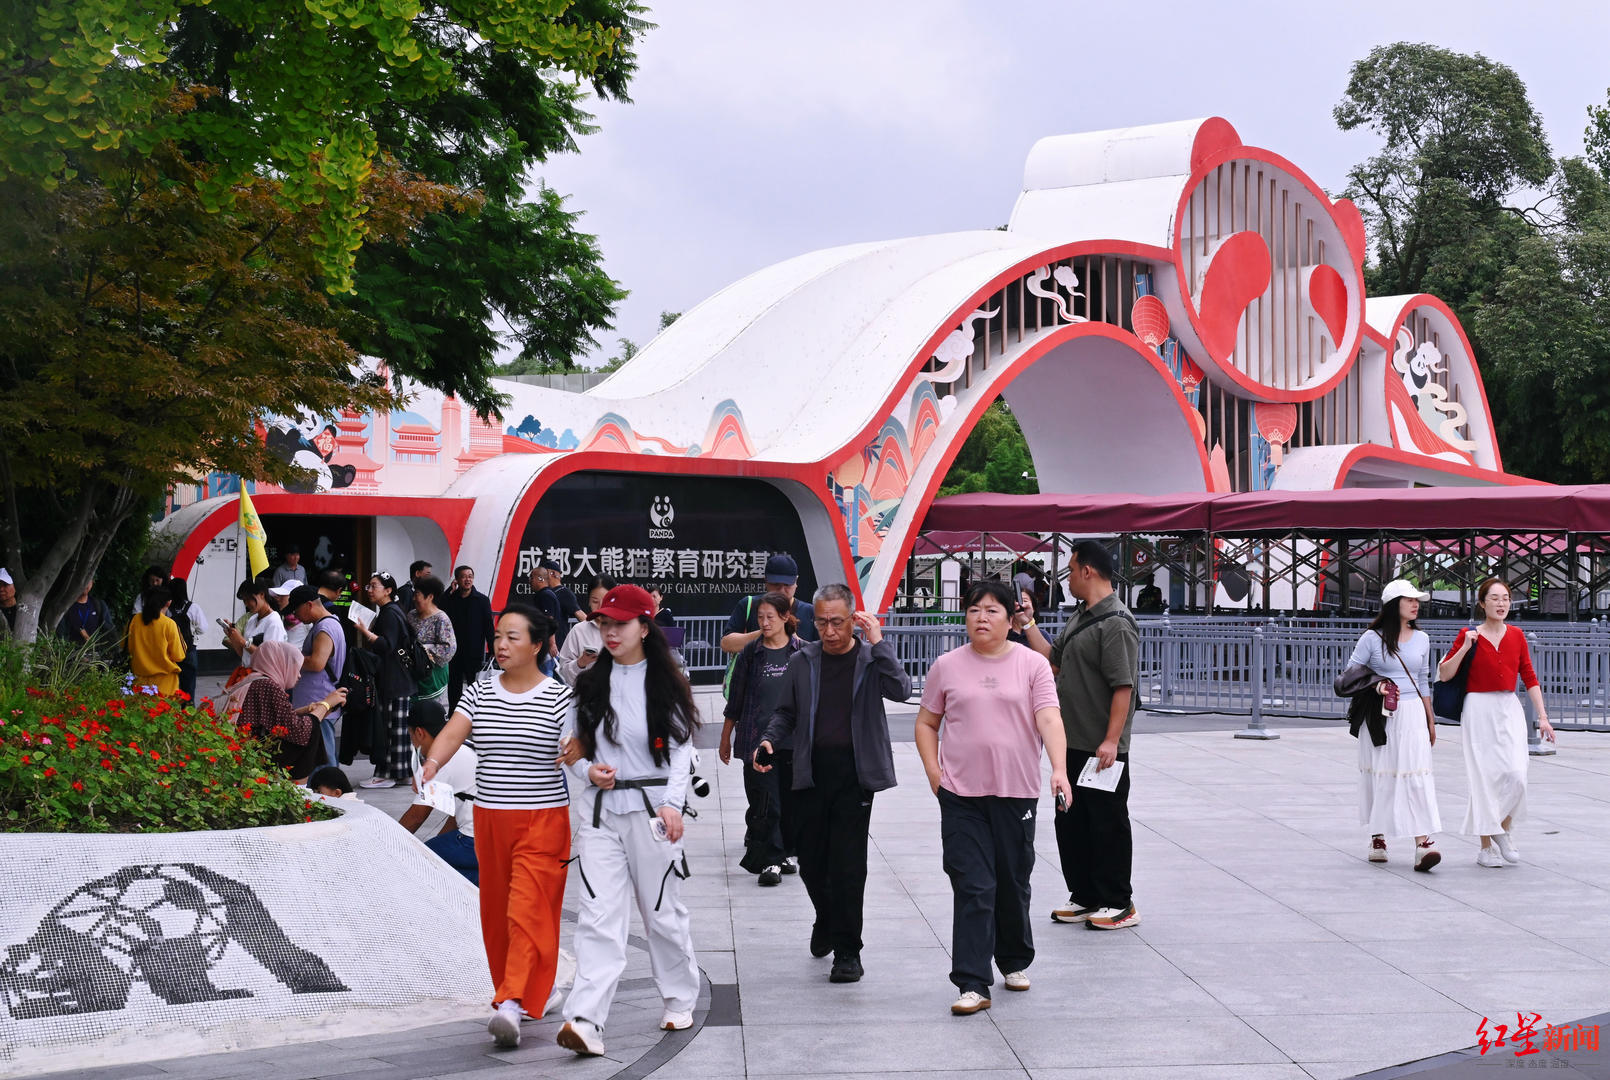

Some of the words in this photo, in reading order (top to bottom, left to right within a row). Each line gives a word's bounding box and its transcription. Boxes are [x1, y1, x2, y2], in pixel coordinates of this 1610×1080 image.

[649, 528, 675, 539] PANDA
[517, 546, 792, 579] 成都大熊猫繁育研究基
[659, 582, 673, 594] OF
[675, 582, 707, 594] GIANT
[709, 582, 742, 594] PANDA
